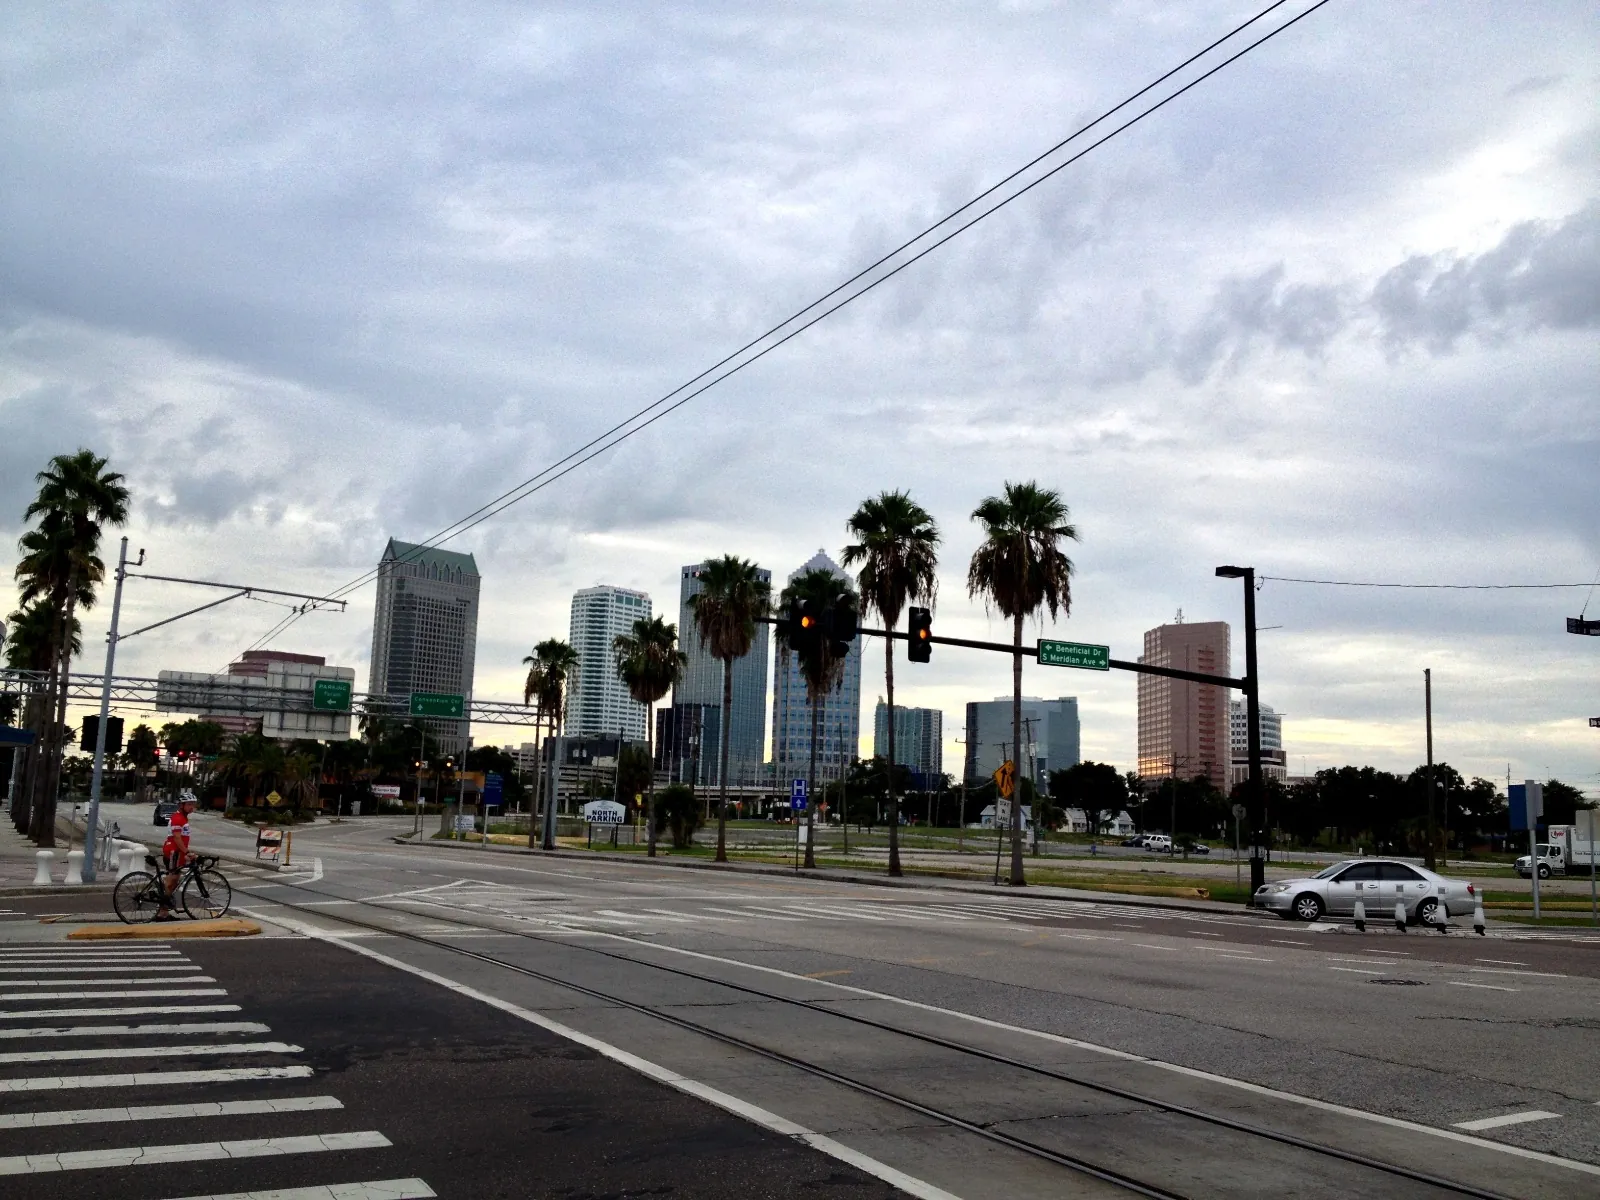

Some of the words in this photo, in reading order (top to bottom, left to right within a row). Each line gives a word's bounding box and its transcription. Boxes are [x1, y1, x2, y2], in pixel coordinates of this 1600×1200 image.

[1055, 644, 1090, 655] Beneficial
[1093, 648, 1102, 656] Dr
[1042, 653, 1048, 661] S
[1050, 653, 1080, 664] Meridian
[1083, 657, 1096, 666] Ave
[318, 683, 347, 691] PARKING
[793, 780, 806, 796] H
[591, 809, 618, 817] NORTH
[586, 814, 623, 823] PARKING
